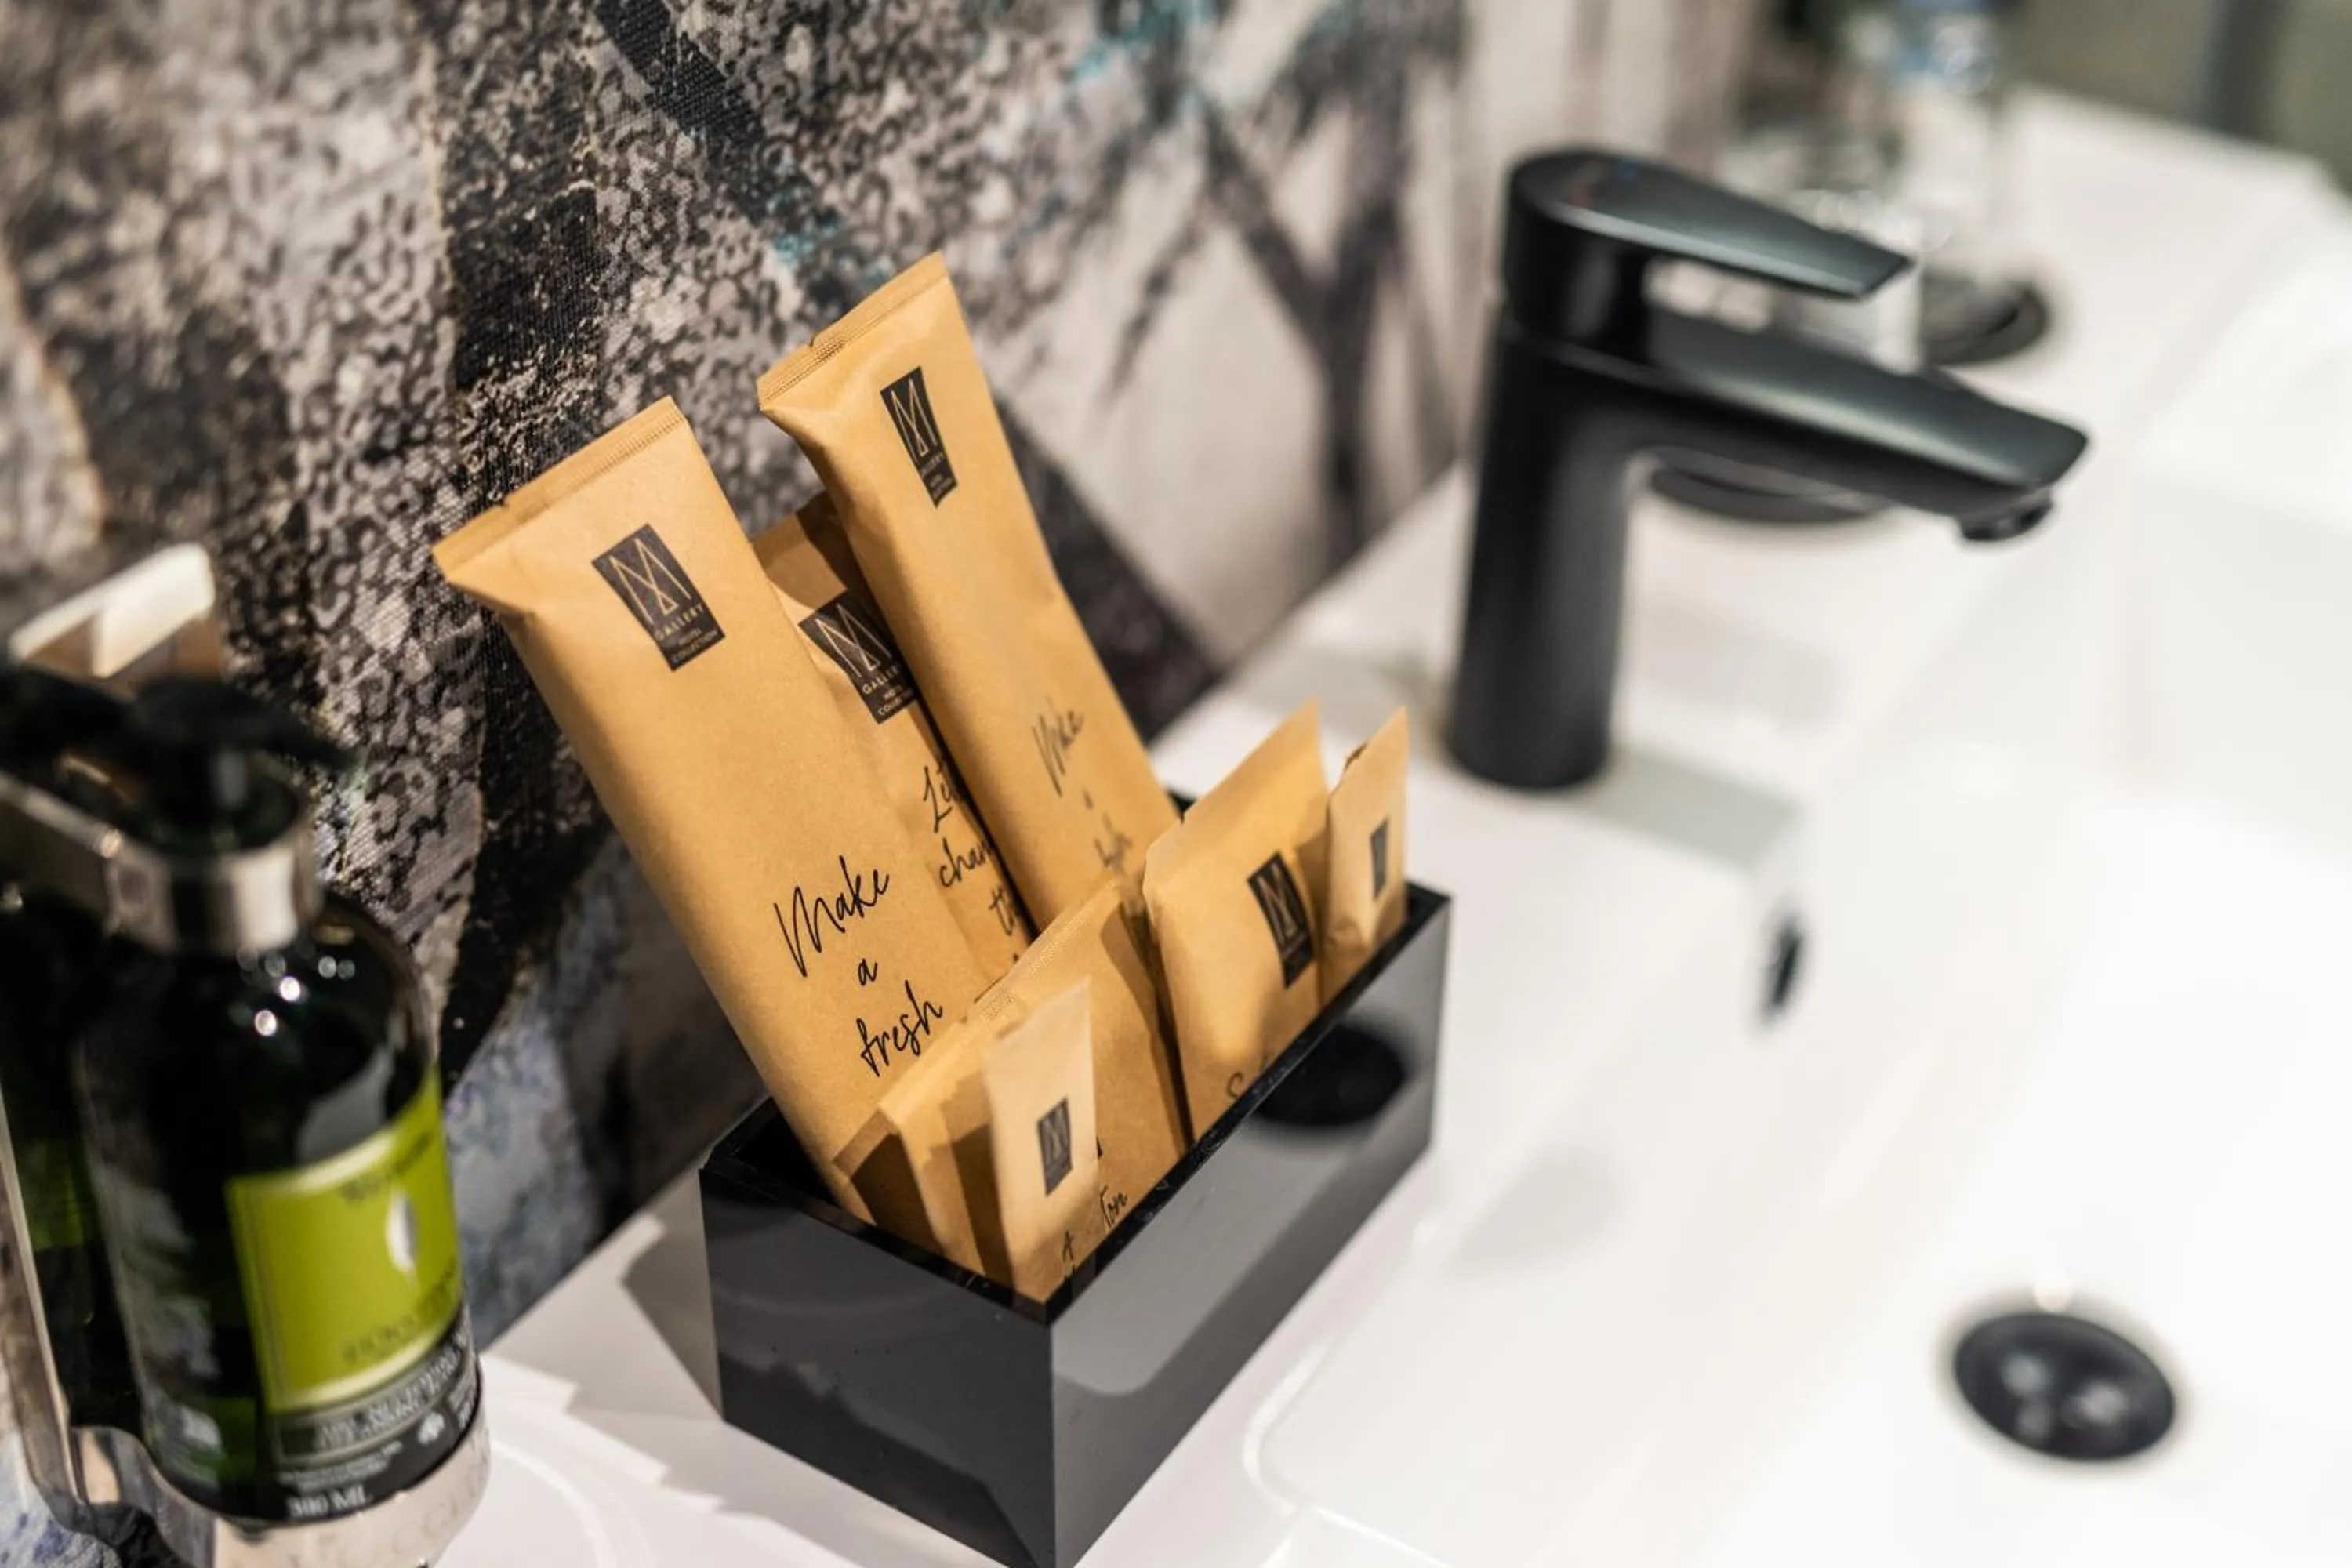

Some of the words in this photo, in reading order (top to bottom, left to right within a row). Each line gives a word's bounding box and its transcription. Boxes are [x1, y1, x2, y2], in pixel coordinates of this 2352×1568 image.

[773, 855, 889, 978] Make
[858, 957, 878, 986] a
[856, 979, 942, 1077] fresh
